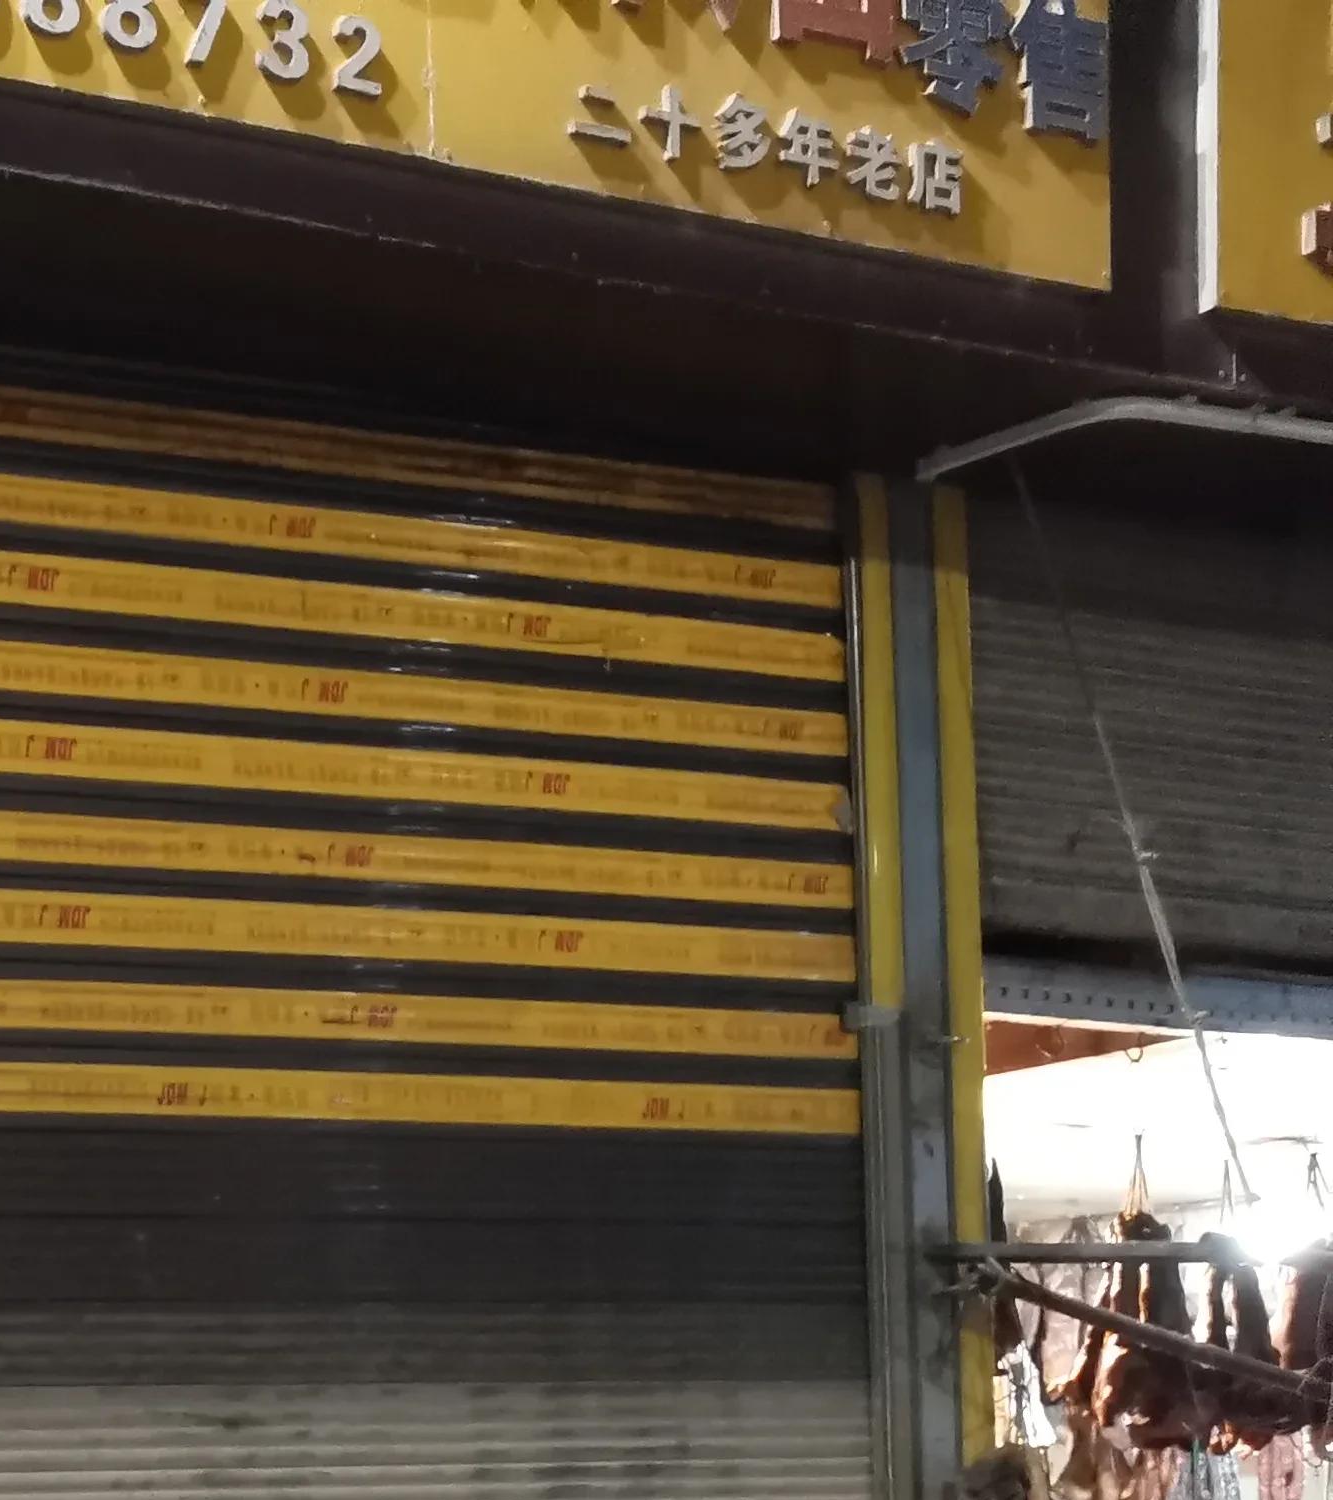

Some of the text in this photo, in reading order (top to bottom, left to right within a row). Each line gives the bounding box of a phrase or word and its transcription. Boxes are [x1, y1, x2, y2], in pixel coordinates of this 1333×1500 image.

[567, 83, 964, 217] 二十多年老店
